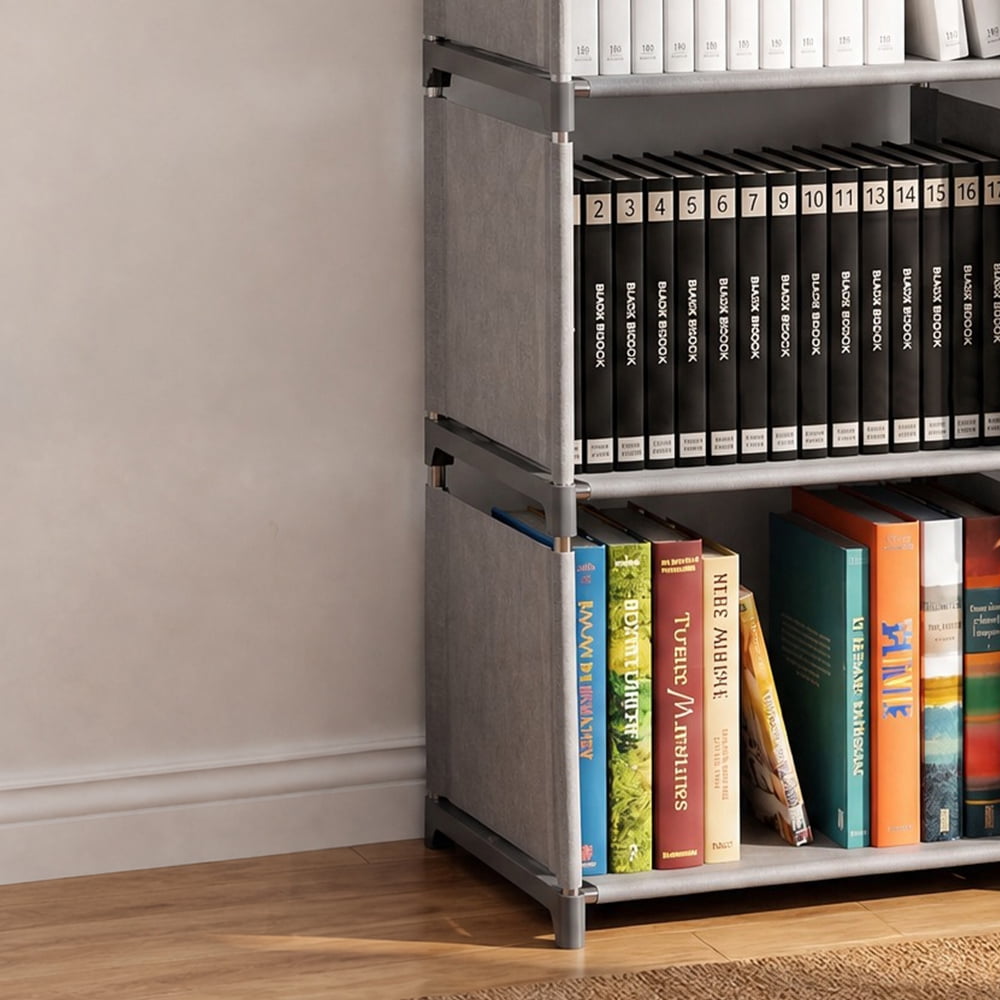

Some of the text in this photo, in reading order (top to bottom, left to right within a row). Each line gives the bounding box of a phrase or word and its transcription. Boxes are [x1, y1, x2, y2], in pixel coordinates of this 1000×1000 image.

[778, 191, 789, 210] 9
[804, 190, 824, 208] 10
[835, 189, 853, 207] 11
[866, 187, 885, 205] 13
[896, 185, 916, 204] 14
[927, 183, 946, 202] 15
[957, 182, 977, 201] 16
[593, 199, 604, 218] 2
[624, 198, 635, 217] 3
[654, 197, 666, 216] 4
[686, 196, 697, 215] 5
[717, 194, 728, 213] 6
[748, 193, 758, 211] 7
